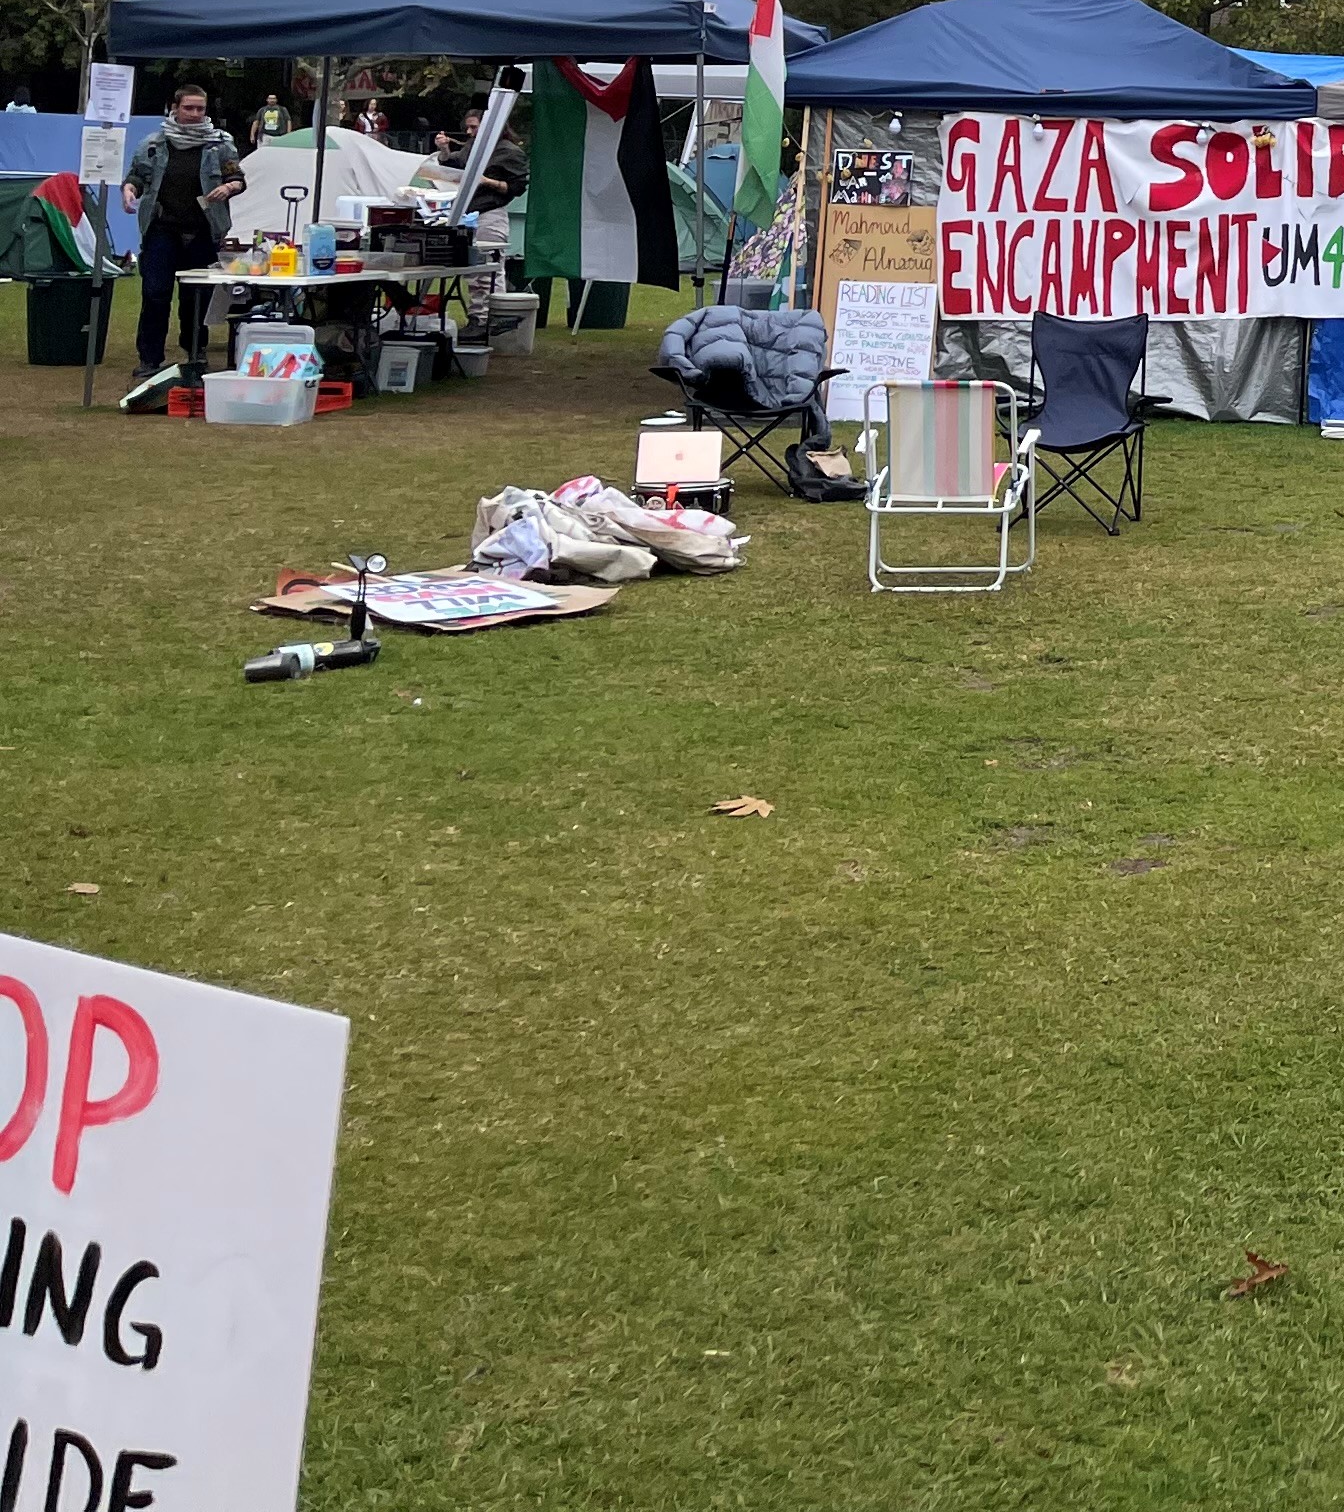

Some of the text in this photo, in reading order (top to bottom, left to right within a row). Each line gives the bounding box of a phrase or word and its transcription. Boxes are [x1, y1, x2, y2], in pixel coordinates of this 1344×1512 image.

[947, 117, 1118, 212] GAZA
[833, 210, 911, 235] Mahmoud
[941, 213, 1257, 317] ENCAMPMENT
[841, 284, 932, 308] READING LIST
[834, 351, 916, 369] ON PALESTINE
